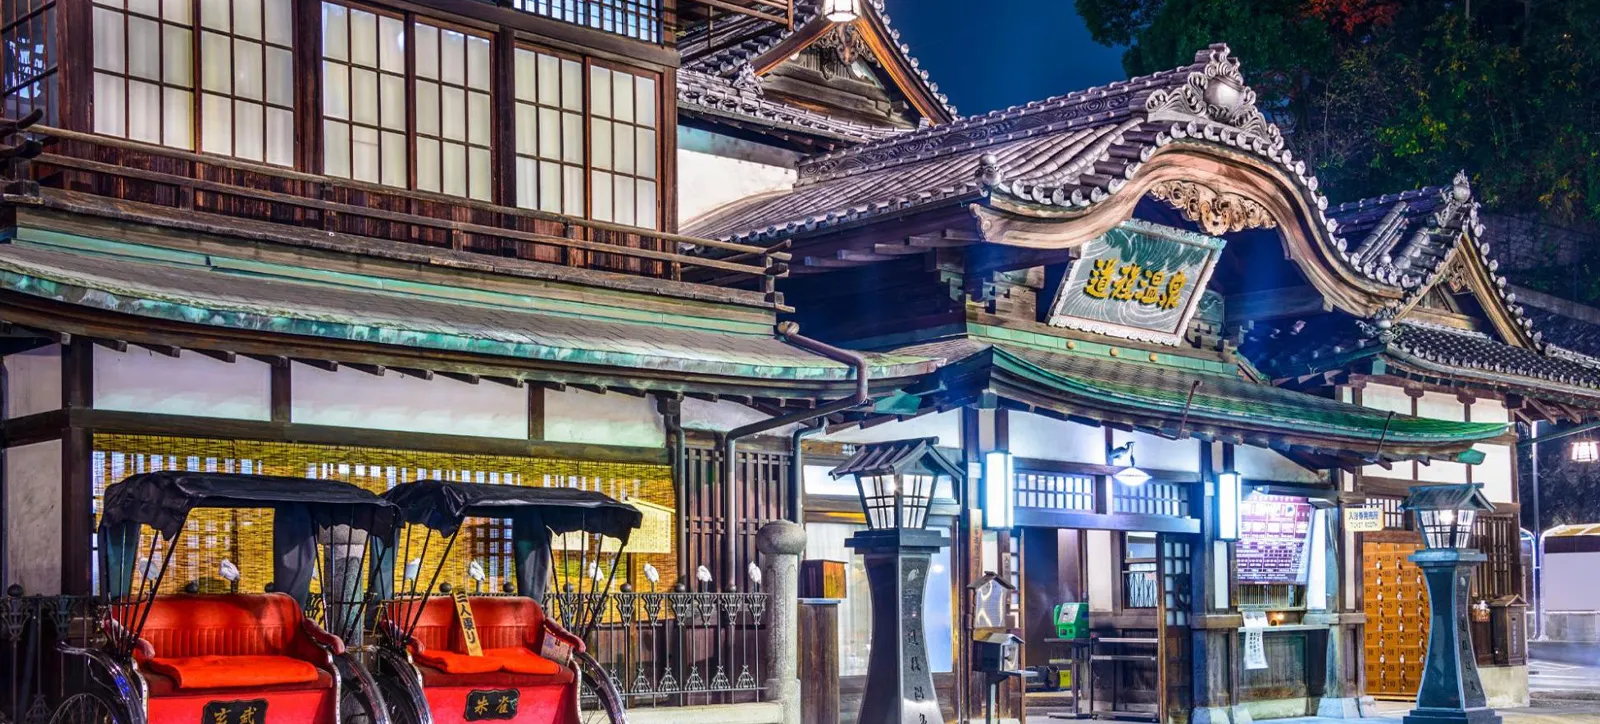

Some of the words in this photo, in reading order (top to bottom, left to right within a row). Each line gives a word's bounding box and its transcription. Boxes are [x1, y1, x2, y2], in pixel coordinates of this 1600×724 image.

[1084, 258, 1186, 310] 道後温泉
[456, 590, 477, 644] 三人乗り
[214, 706, 258, 724] 玄武
[473, 695, 510, 716] 朱雀
